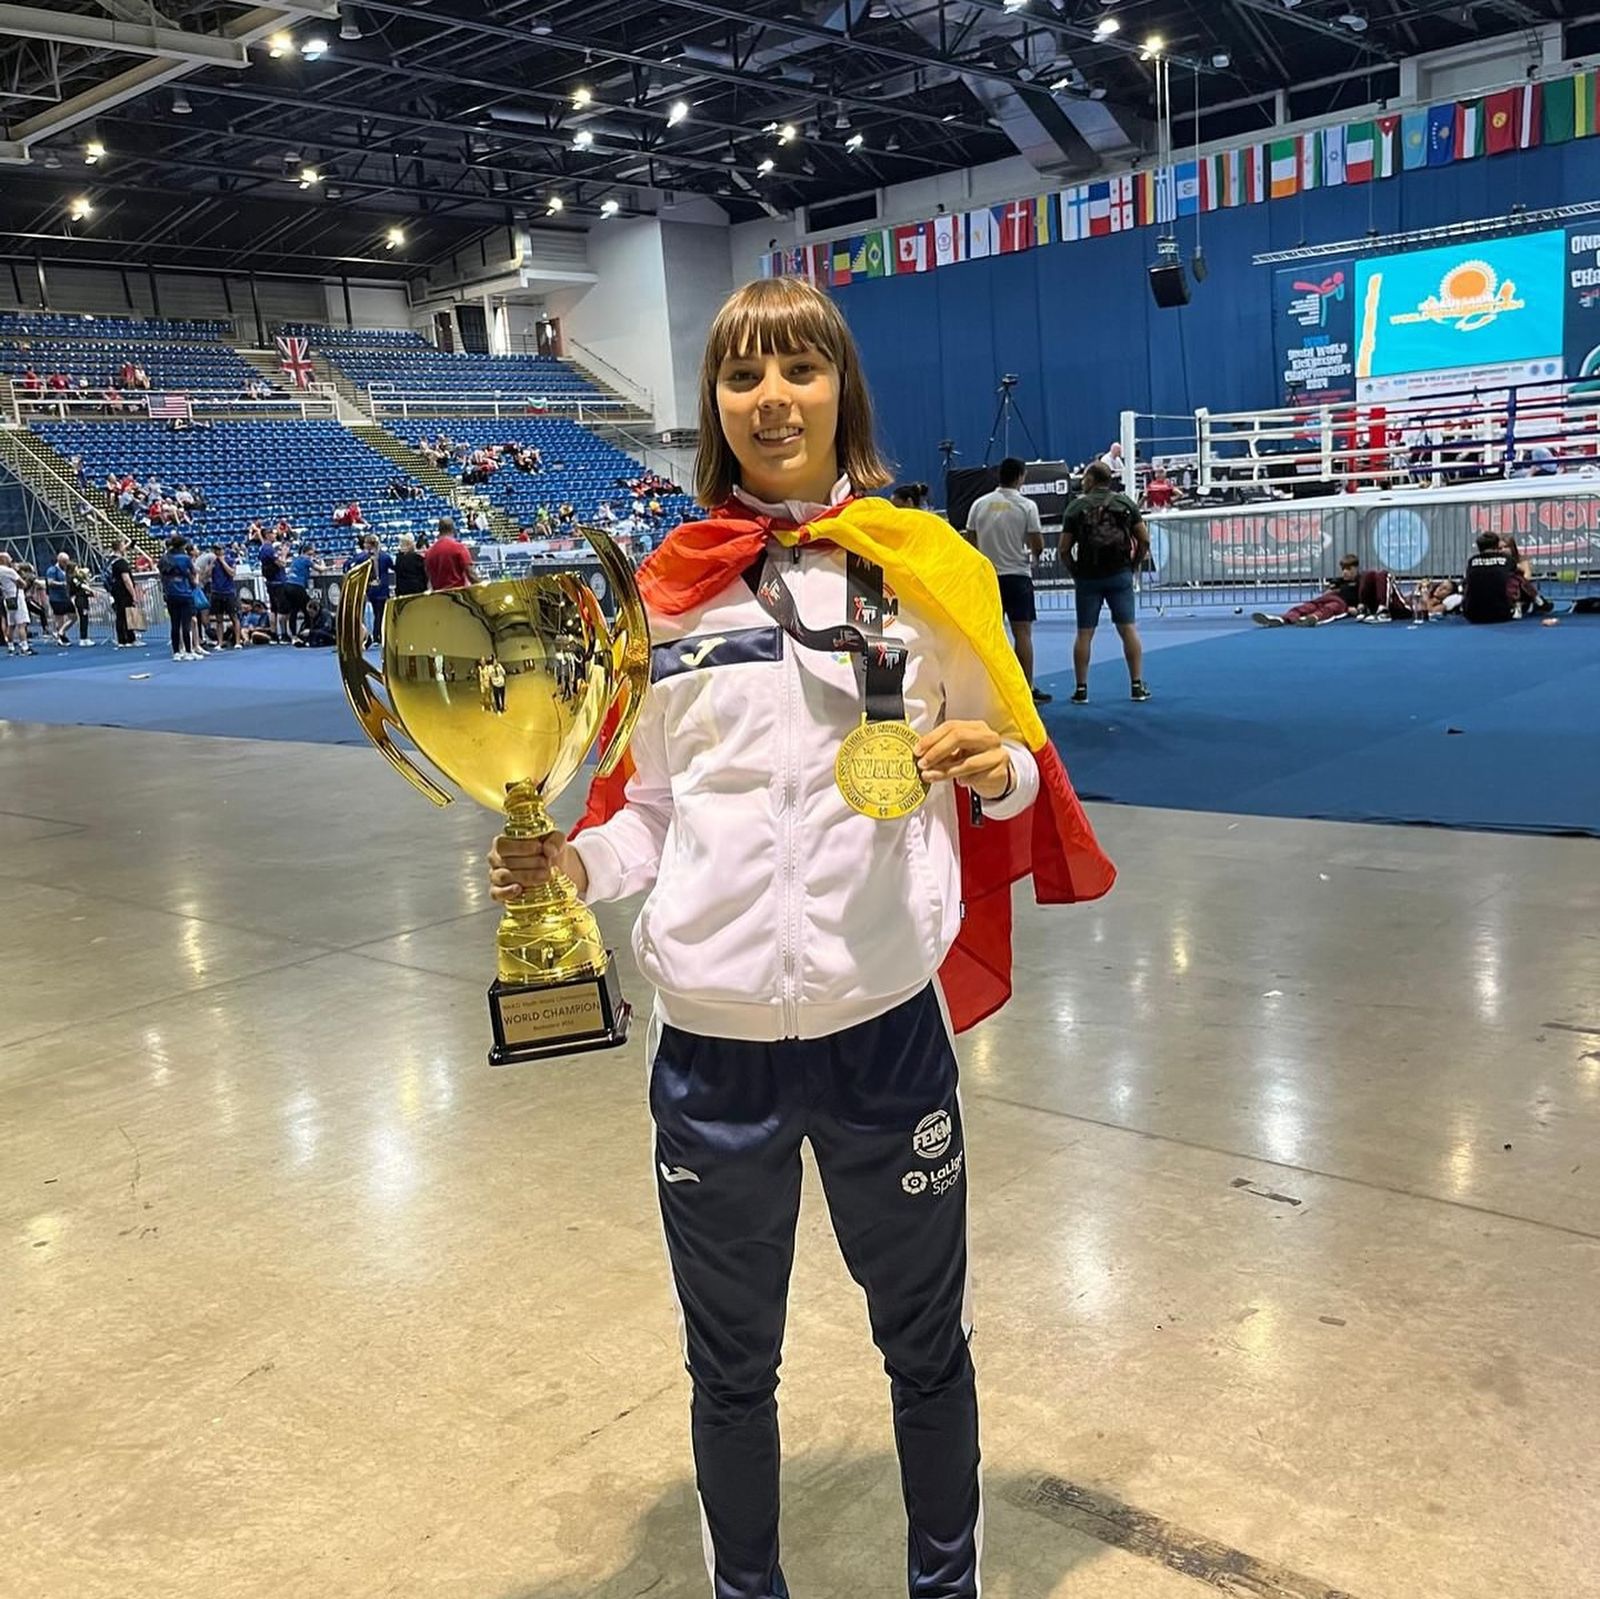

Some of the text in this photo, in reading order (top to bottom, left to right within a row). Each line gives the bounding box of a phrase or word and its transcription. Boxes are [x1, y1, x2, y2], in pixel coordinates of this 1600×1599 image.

[851, 758, 918, 780] WAKO
[503, 1011, 540, 1025] WORLD
[542, 1001, 601, 1020] CHAMPION
